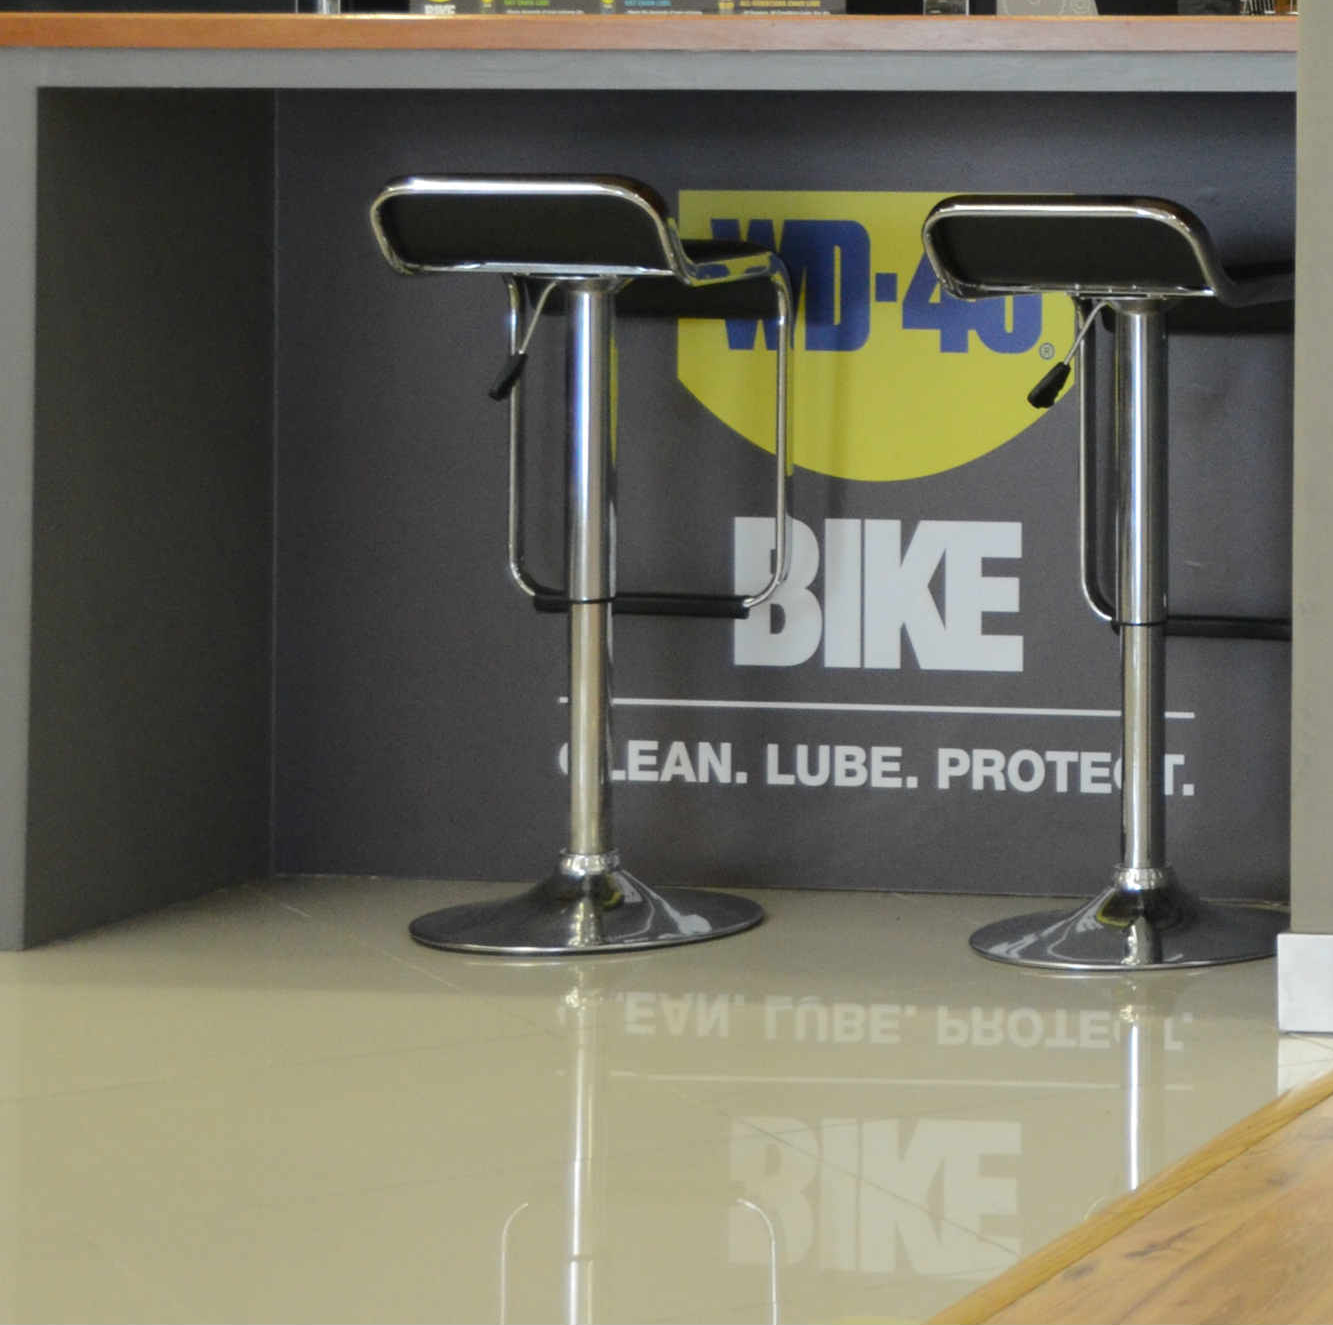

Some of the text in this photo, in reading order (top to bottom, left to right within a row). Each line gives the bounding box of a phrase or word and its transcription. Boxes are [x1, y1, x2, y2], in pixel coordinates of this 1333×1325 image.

[733, 516, 1024, 673] BIKE
[558, 739, 1195, 797] EAN. LUBE. PROTET.
